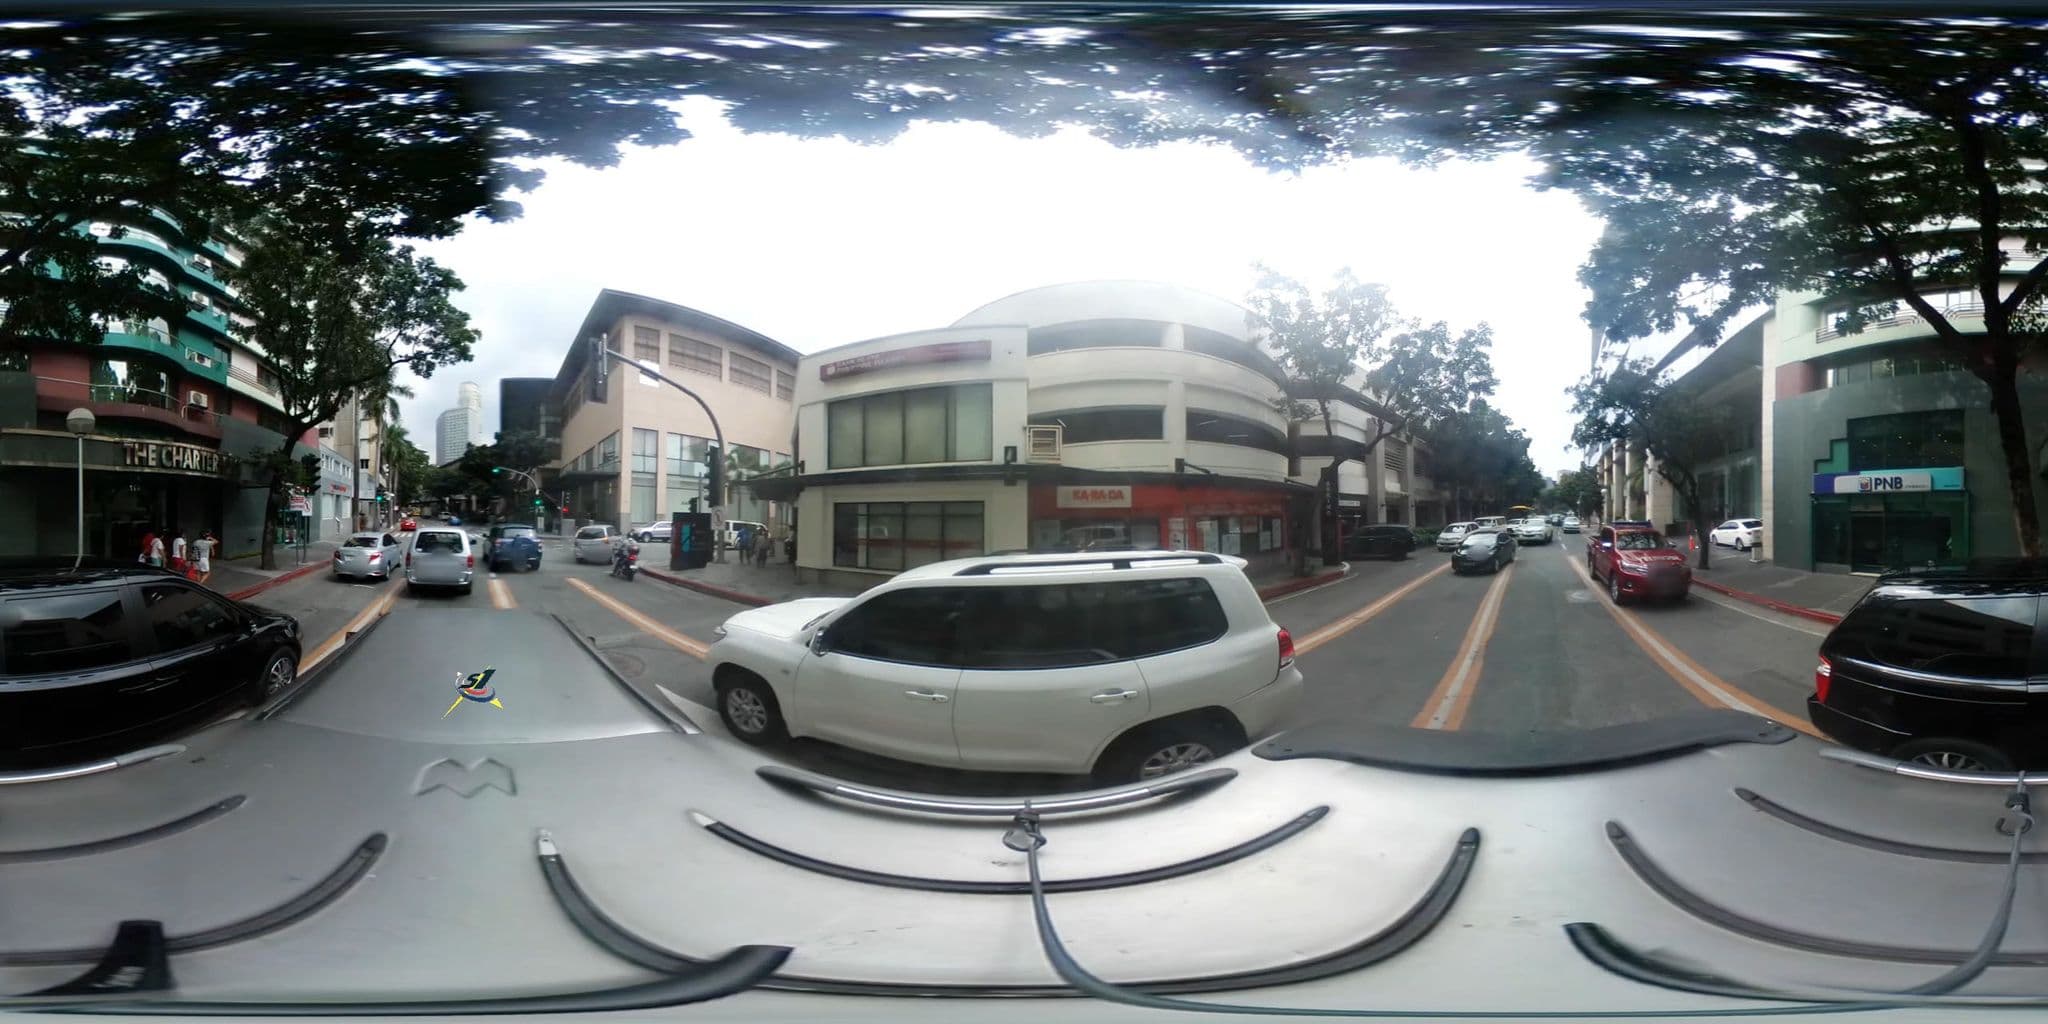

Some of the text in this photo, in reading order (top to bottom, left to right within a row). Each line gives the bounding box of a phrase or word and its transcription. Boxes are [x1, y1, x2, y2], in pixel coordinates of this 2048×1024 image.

[124, 443, 157, 467] THE
[161, 446, 219, 474] CHARTER
[1874, 476, 1903, 490] PNB
